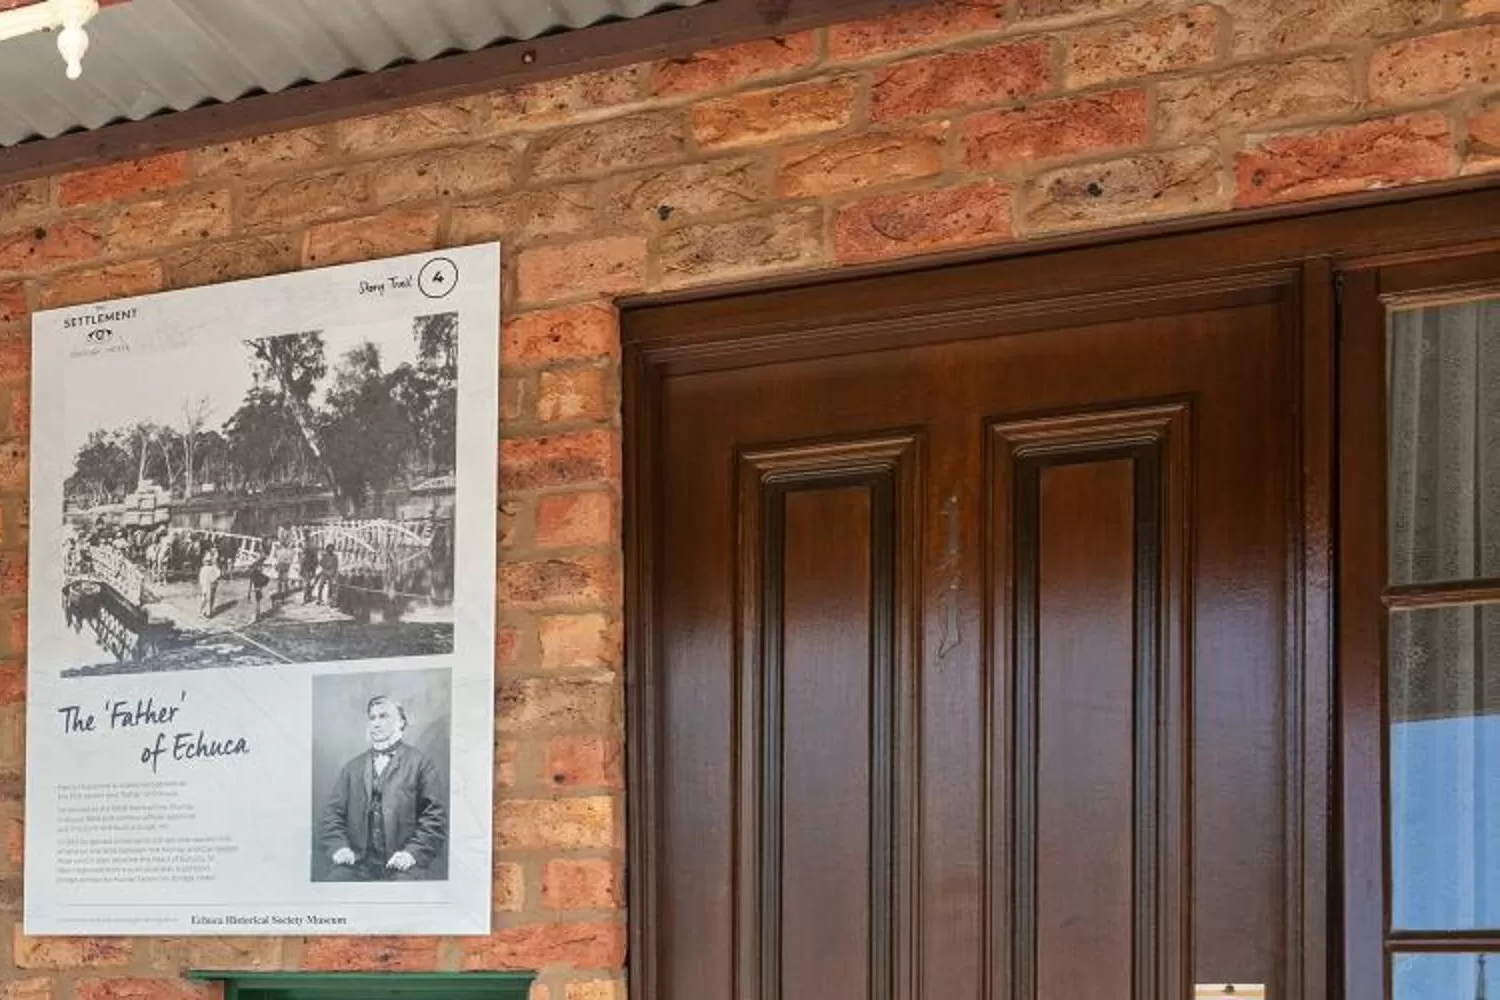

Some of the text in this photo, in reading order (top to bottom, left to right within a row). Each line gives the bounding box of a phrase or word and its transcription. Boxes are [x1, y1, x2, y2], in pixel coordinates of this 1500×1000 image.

[64, 308, 137, 329] SETTLEMENT
[58, 705, 96, 734] The
[140, 730, 251, 774] of Echuca
[191, 915, 223, 925] Echuca
[225, 915, 269, 925] Historical
[271, 915, 303, 926] Society
[306, 915, 348, 925] Museum
